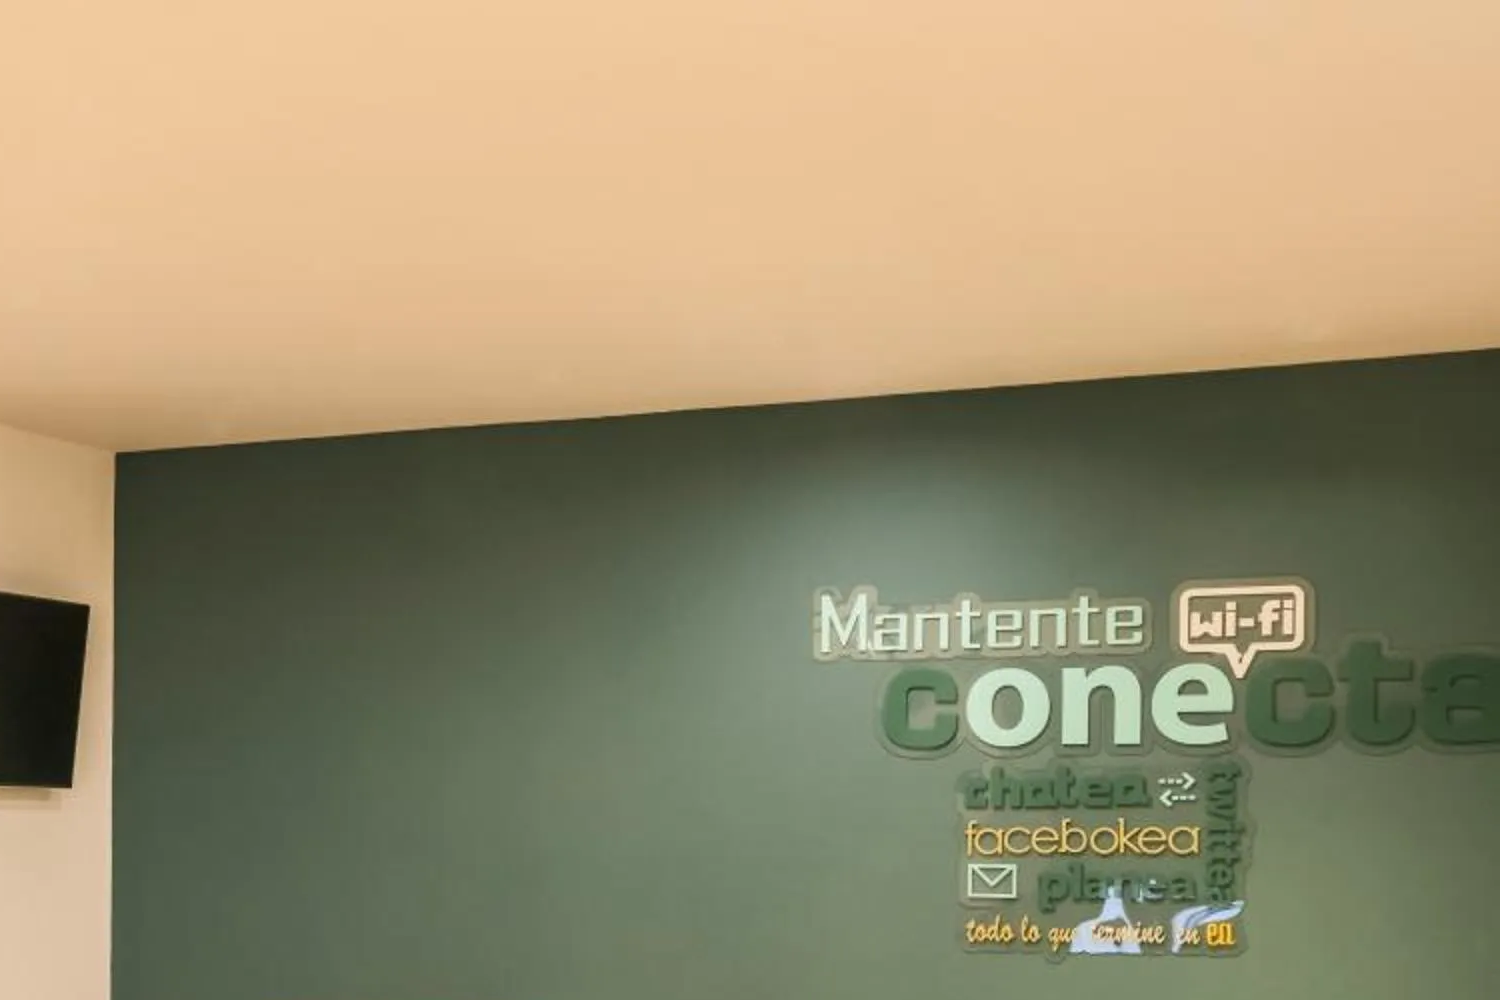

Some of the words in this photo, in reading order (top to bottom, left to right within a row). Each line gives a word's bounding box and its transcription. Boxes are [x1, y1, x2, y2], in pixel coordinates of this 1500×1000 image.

[819, 593, 1145, 653] Mantente
[1190, 599, 1294, 638] wi-fi
[963, 765, 1151, 810] chatea
[964, 817, 1201, 857] facebokea
[1037, 863, 1198, 914] planea
[965, 914, 1014, 944] todo
[1020, 916, 1041, 944] lo
[1176, 925, 1201, 946] en
